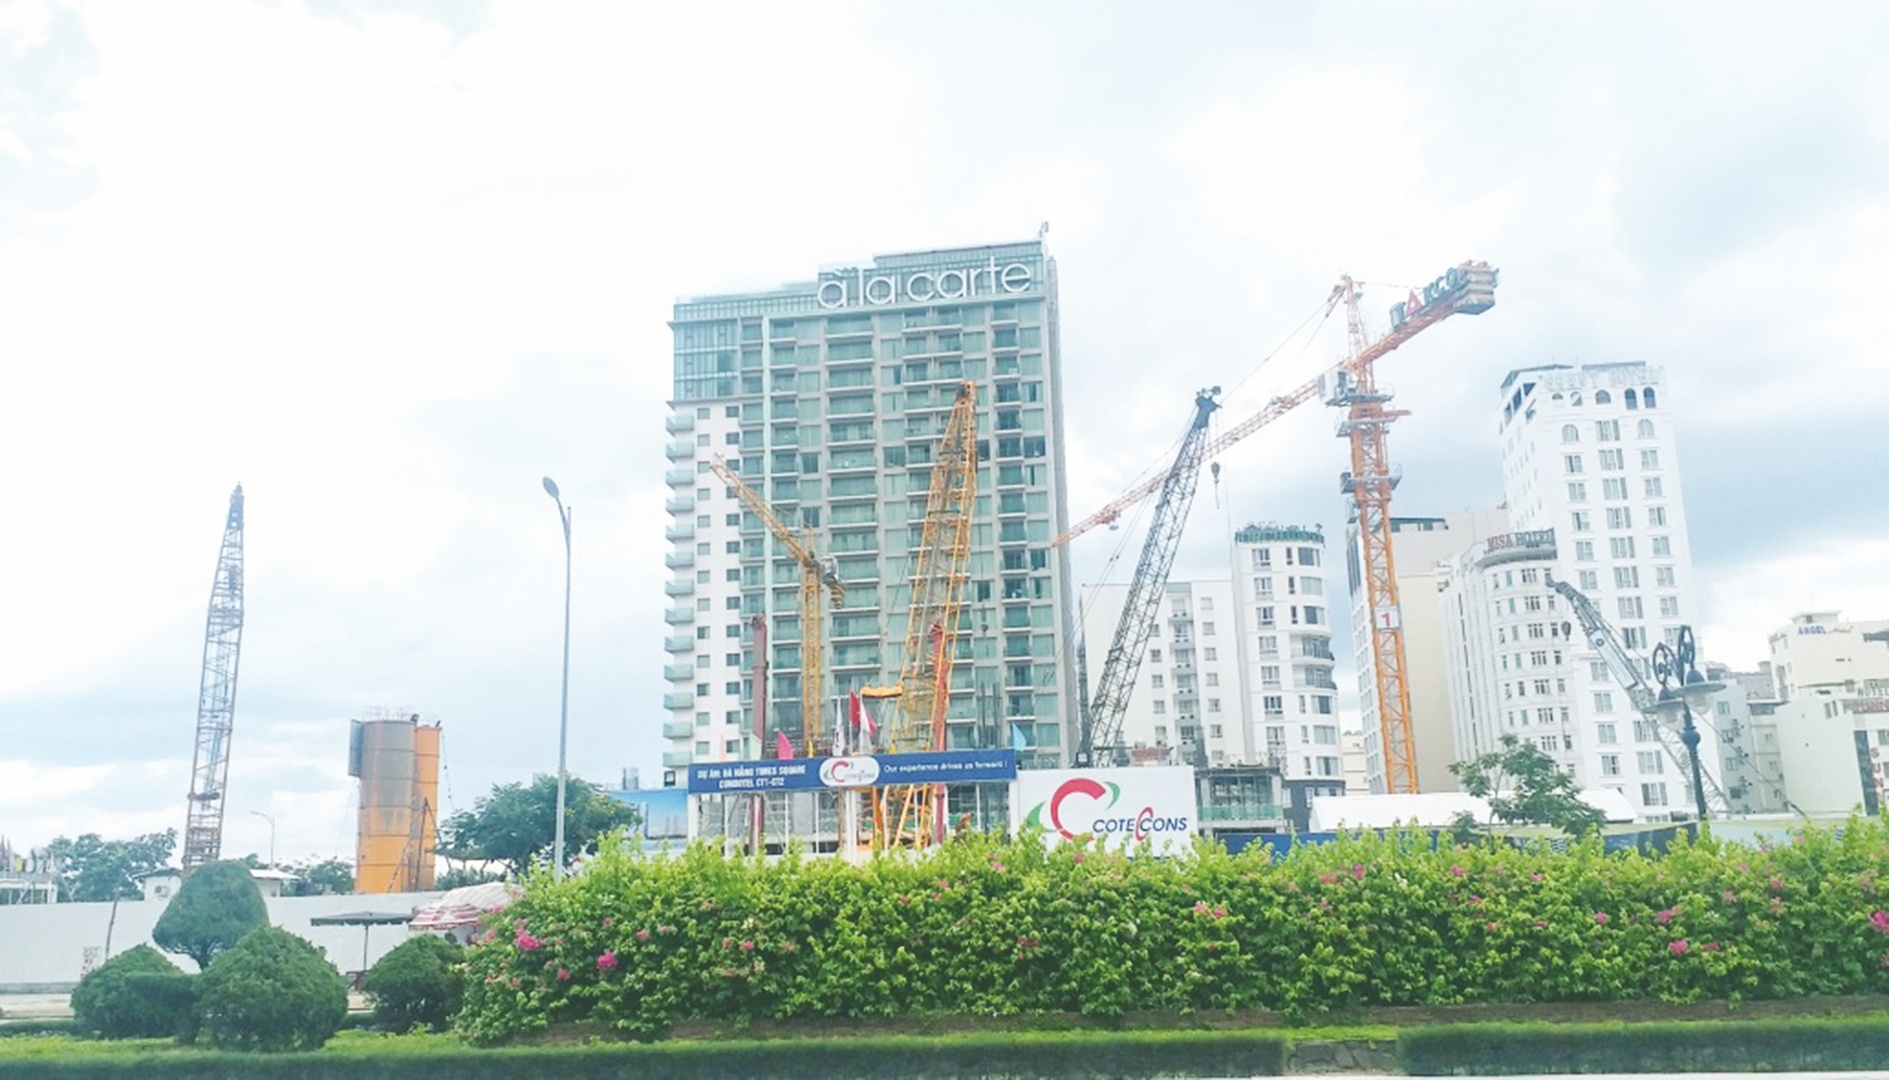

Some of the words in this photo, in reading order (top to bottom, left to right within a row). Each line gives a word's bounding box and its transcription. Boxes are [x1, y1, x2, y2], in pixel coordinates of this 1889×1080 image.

[858, 267, 897, 306] la
[906, 255, 1031, 301] carte
[1382, 612, 1390, 627] 1
[884, 764, 898, 773] Our
[899, 763, 938, 774] experience
